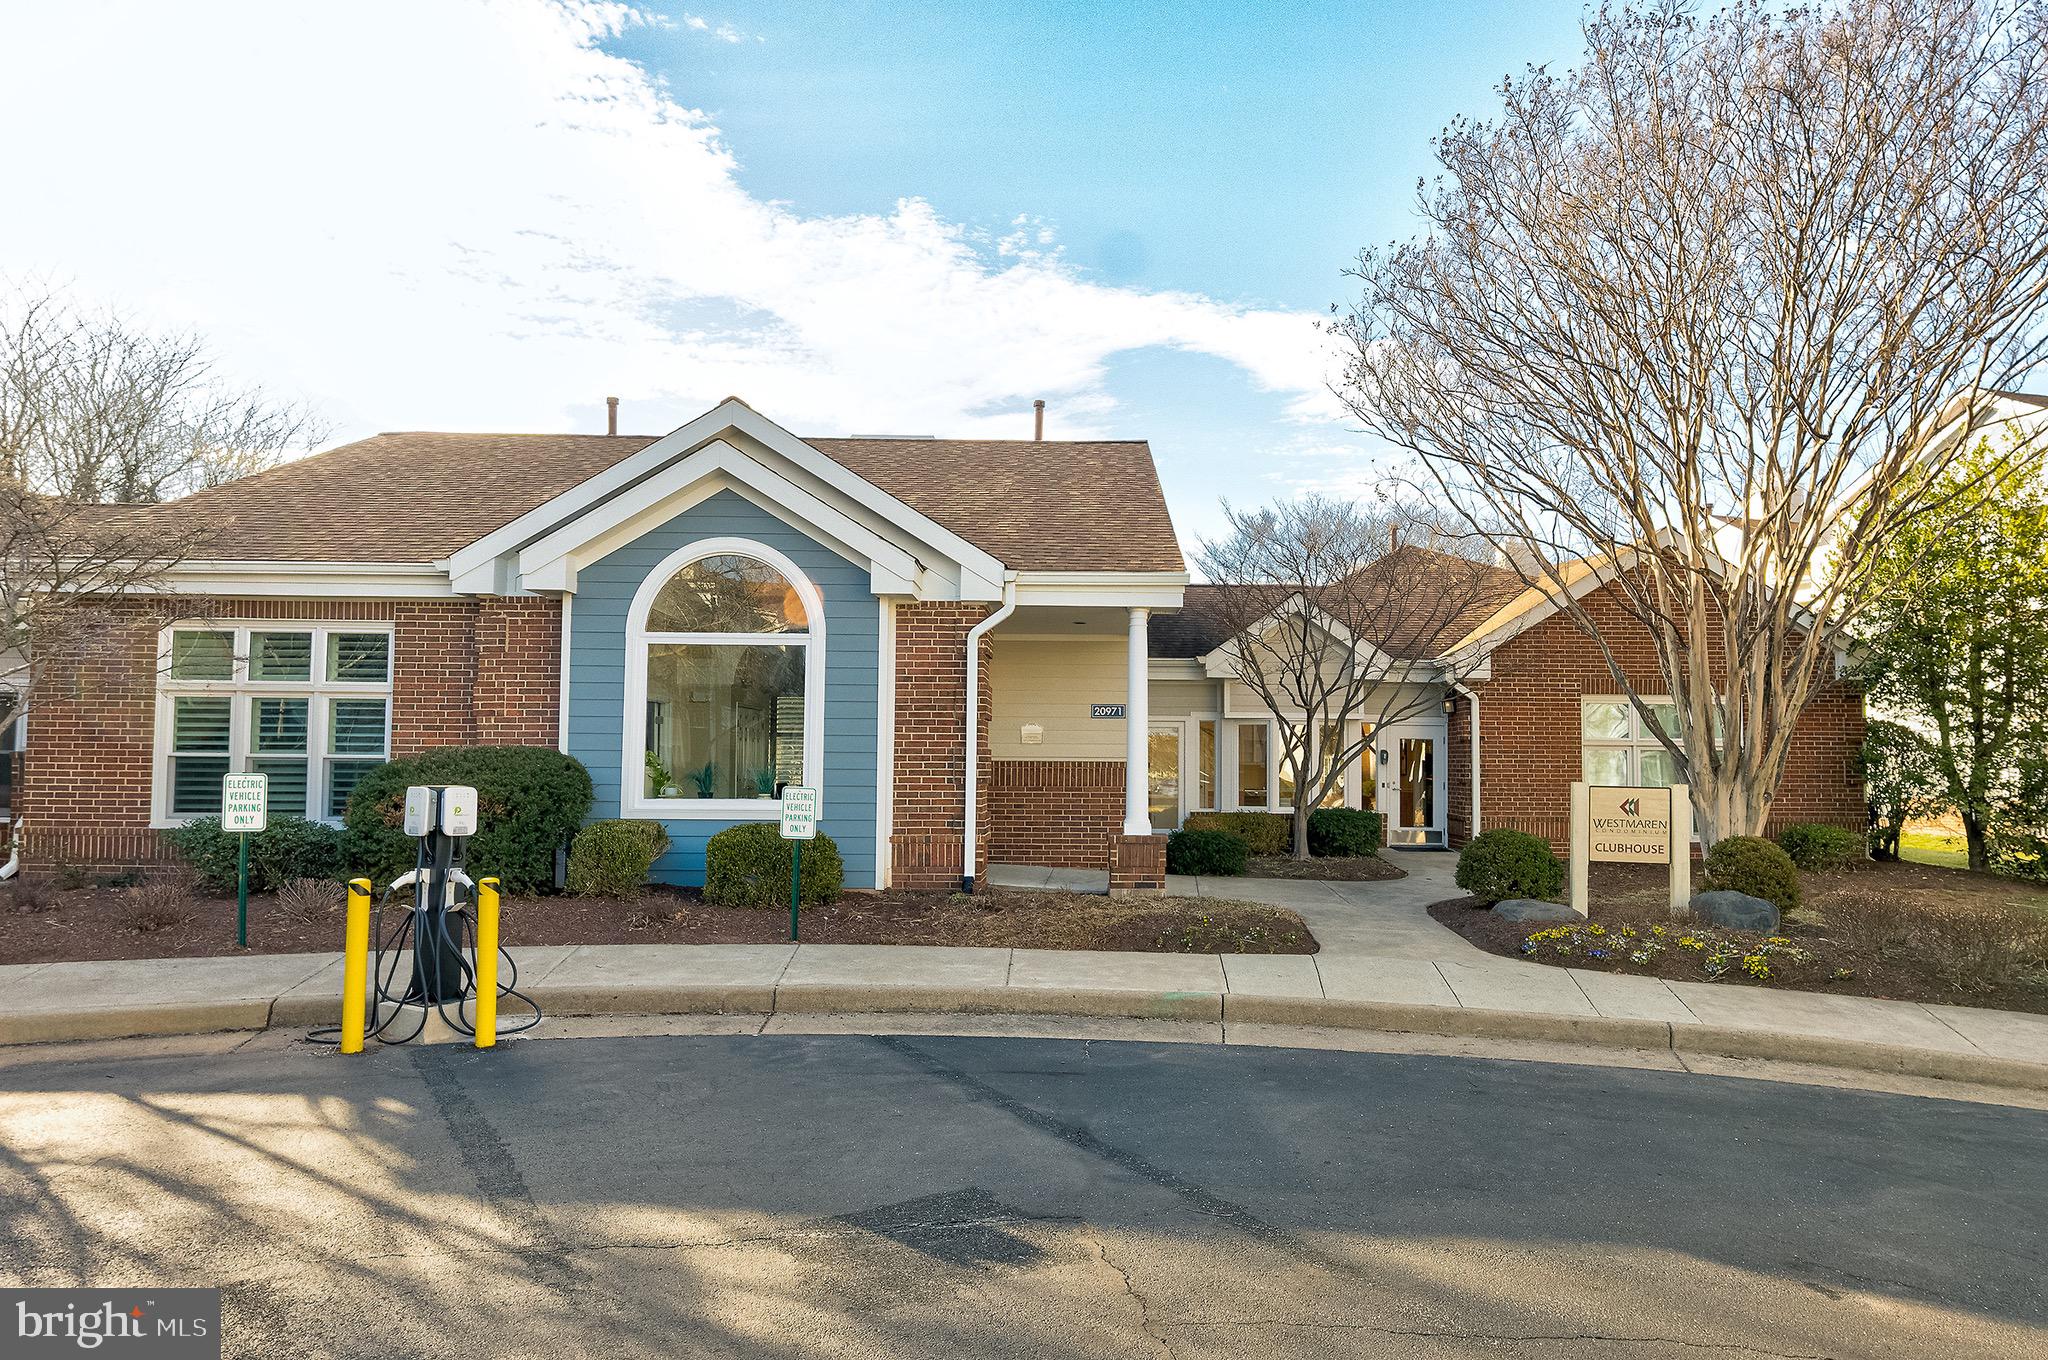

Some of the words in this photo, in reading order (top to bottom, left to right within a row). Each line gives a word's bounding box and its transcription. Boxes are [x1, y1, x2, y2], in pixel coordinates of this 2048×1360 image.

[1094, 706, 1122, 716] 20971
[228, 780, 263, 789] ELECTRIC
[230, 791, 261, 801] VEHICLE
[785, 792, 814, 801] ELECTRIC
[228, 803, 262, 812] PARKING
[786, 803, 812, 812] VEHICLE
[234, 815, 255, 825] ONLY
[785, 813, 813, 823] PARKING
[789, 824, 807, 833] ONLY
[1592, 818, 1668, 830] WESTMAREN
[1595, 842, 1665, 855] CLUBHOUSE
